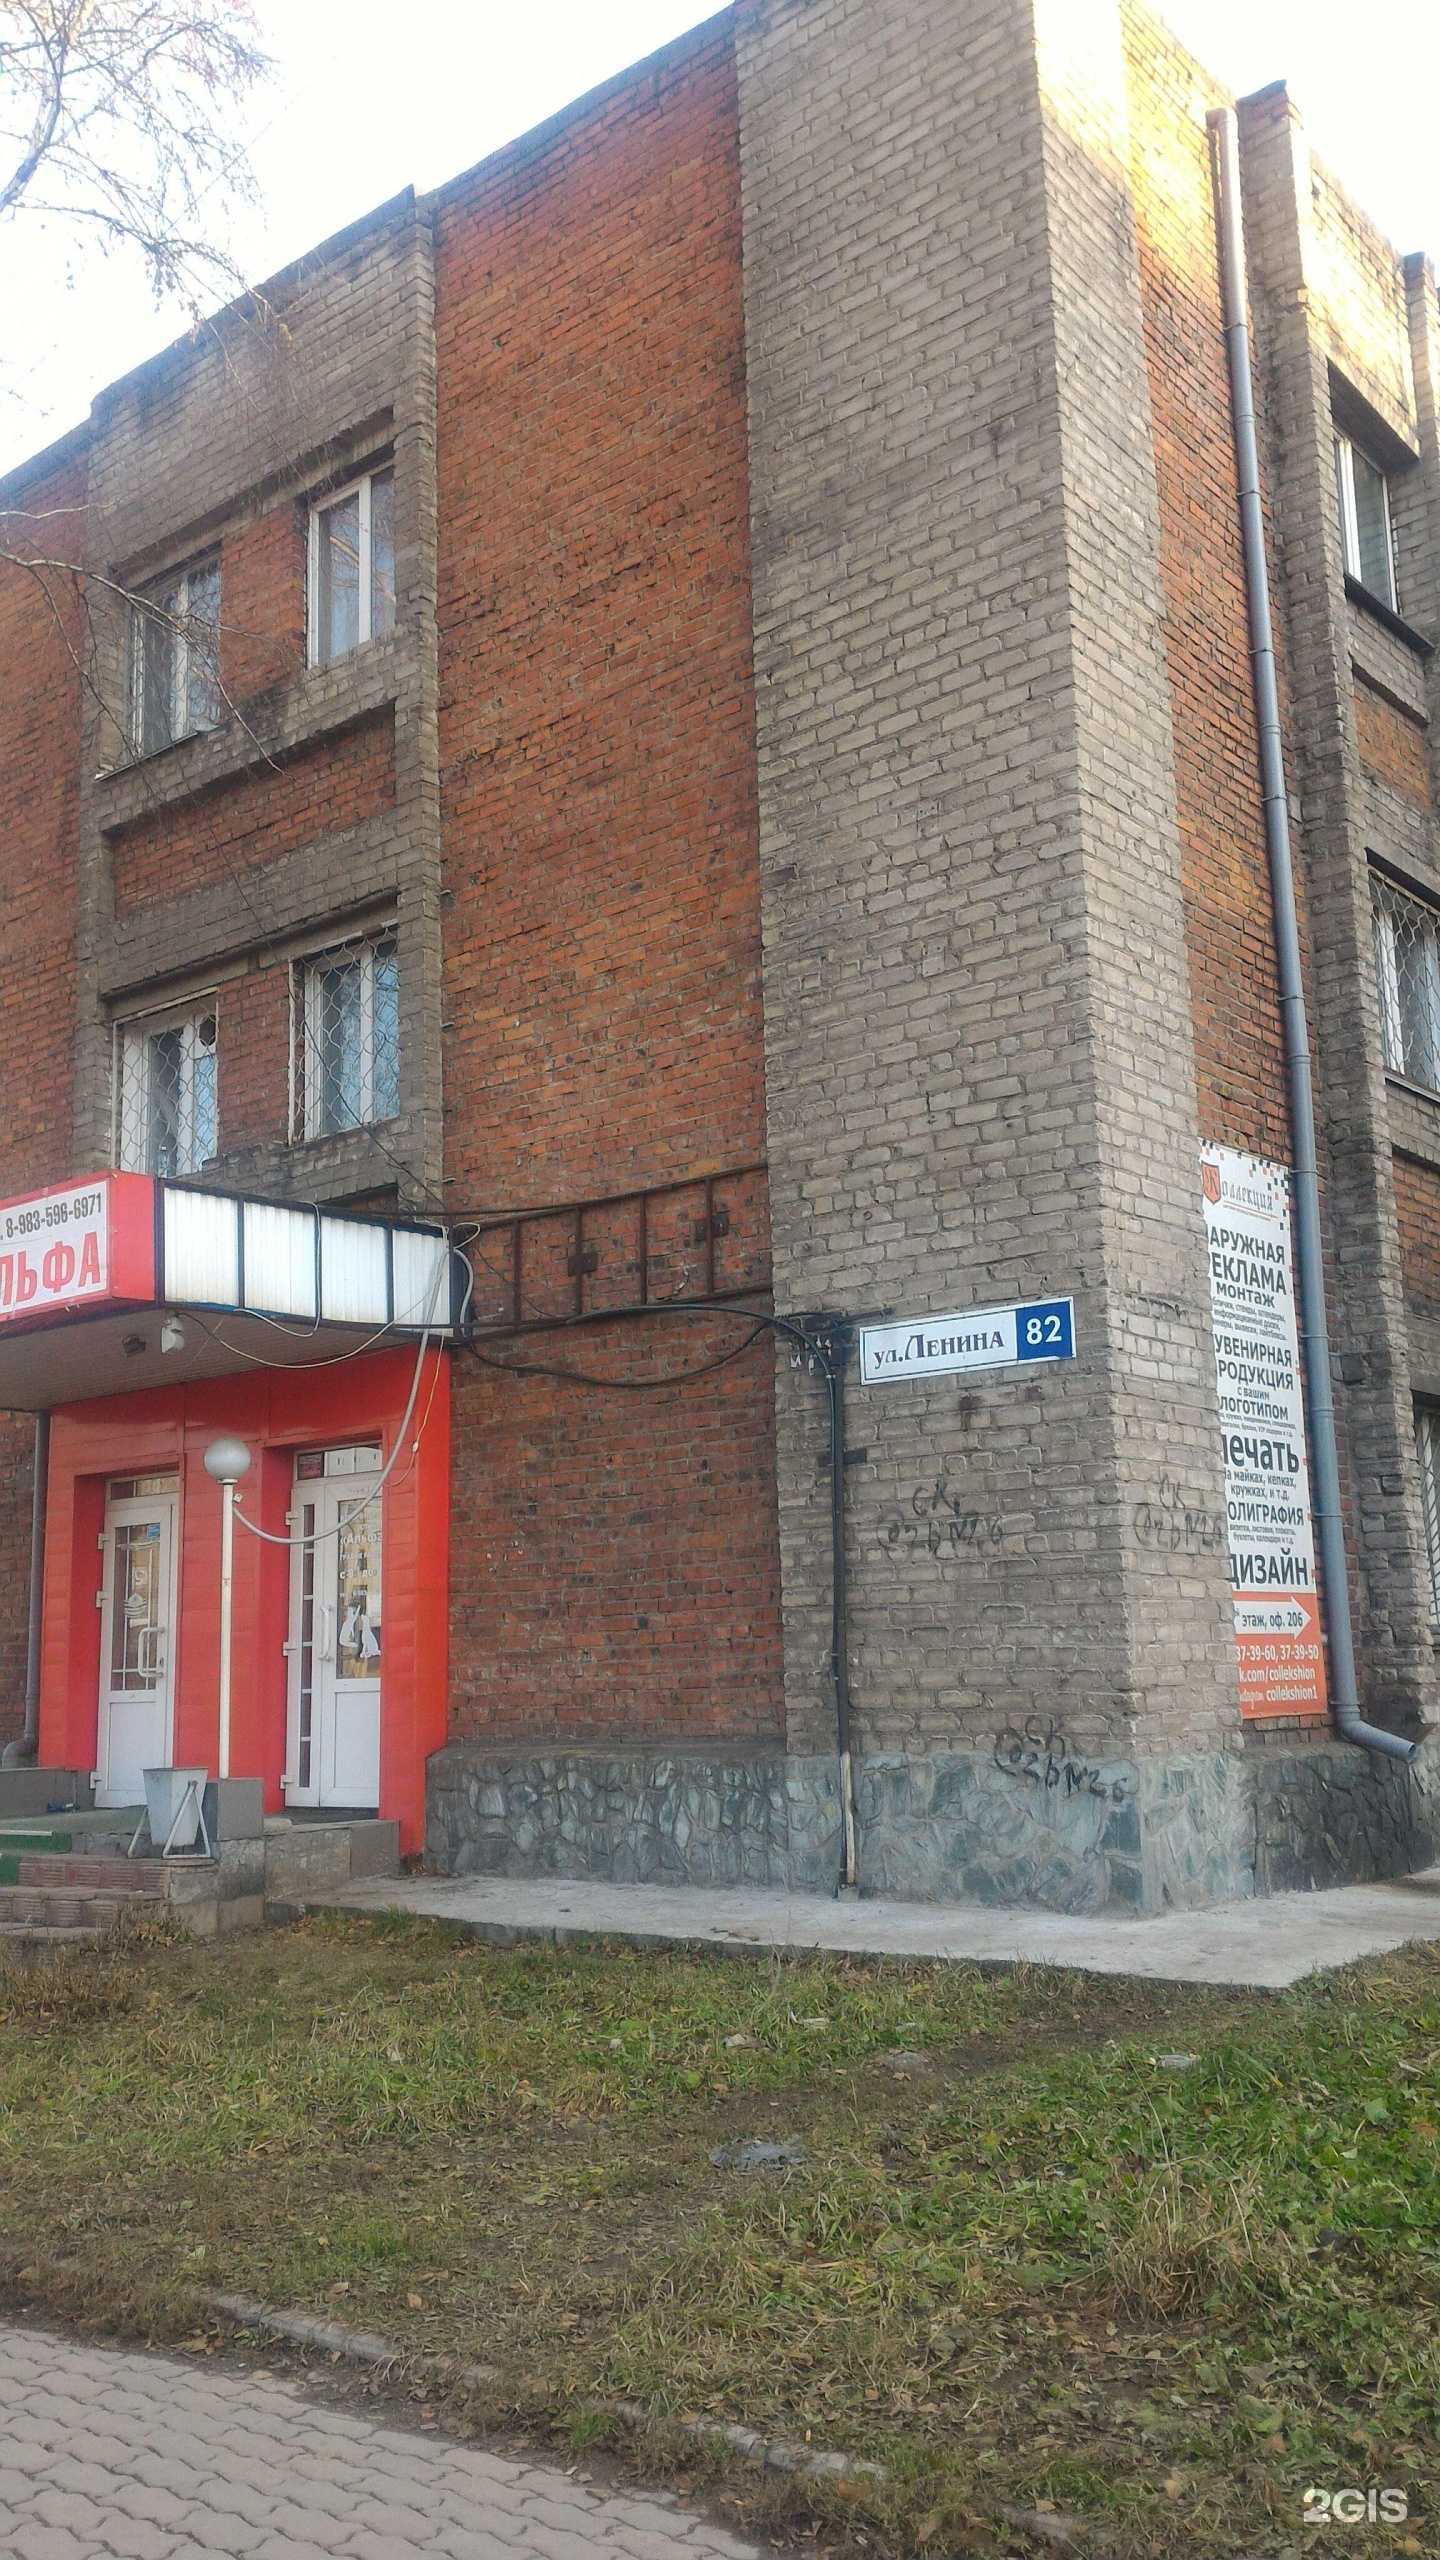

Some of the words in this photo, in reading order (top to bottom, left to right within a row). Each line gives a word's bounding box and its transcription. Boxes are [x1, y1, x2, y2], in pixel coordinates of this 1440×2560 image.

[1212, 1252, 1287, 1295] ЕКЛАМА
[1216, 1282, 1275, 1308] монтаж
[1026, 1315, 1062, 1345] 82
[1215, 1334, 1292, 1368] УВЕНИРНАЯ
[1218, 1360, 1294, 1390] РОДУКЦИЯ
[1228, 1501, 1304, 1526] ОЛИГРАФИЯ
[1287, 1611, 1303, 1627] 206
